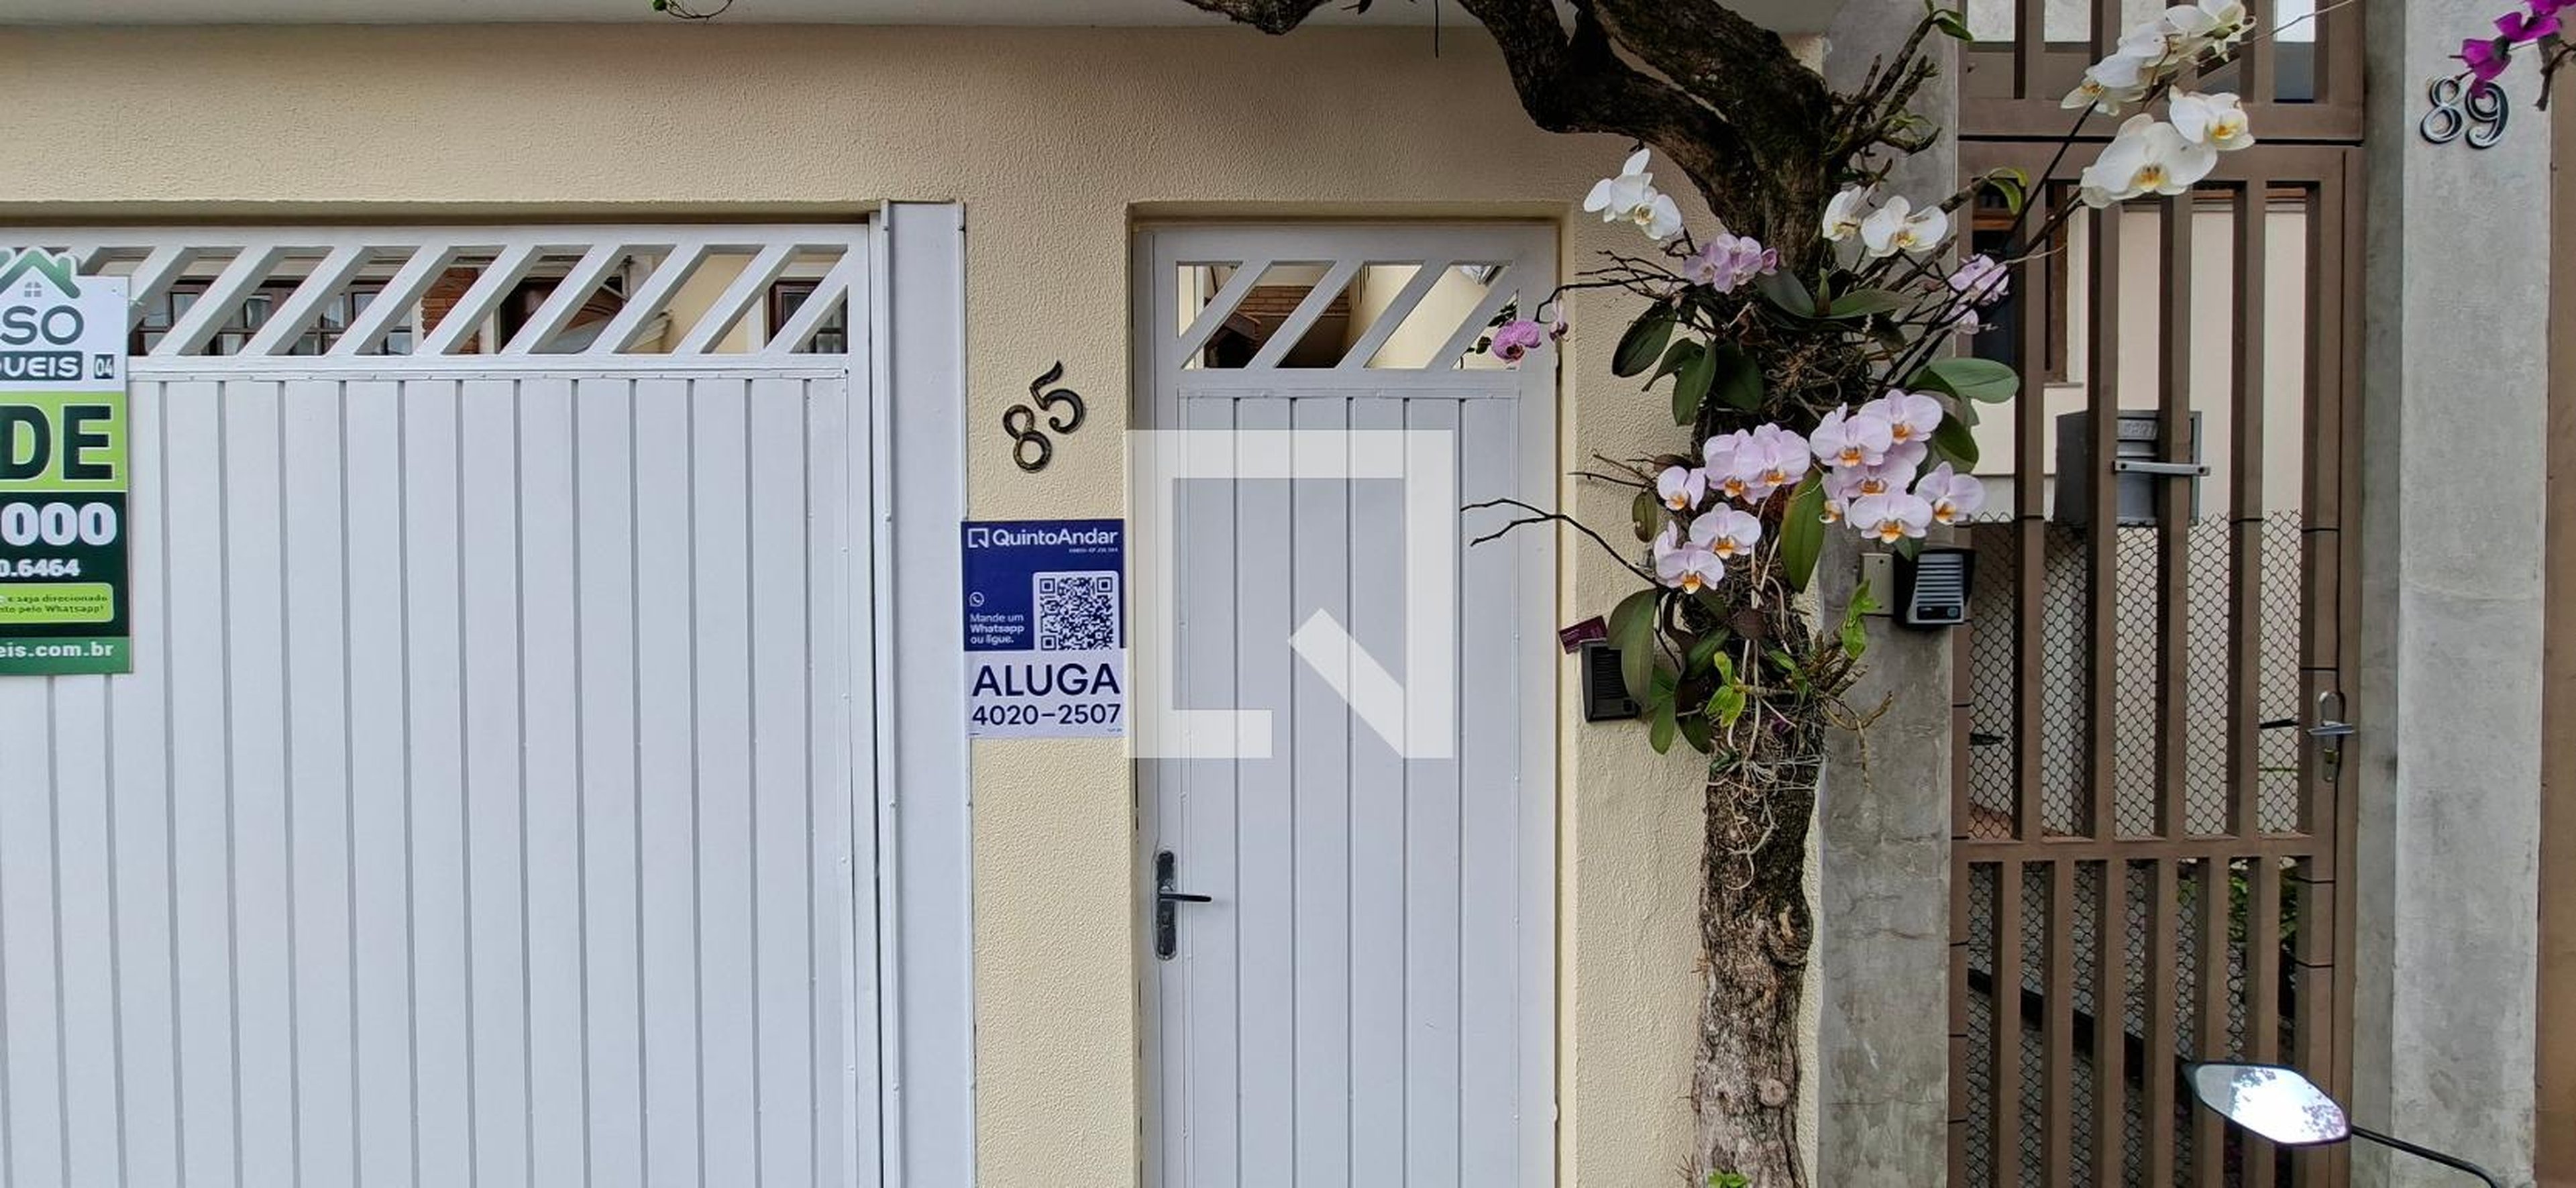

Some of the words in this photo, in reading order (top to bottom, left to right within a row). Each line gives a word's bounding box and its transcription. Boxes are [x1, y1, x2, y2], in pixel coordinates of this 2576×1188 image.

[2420, 76, 2509, 150] 89
[0, 305, 84, 345] SO
[0, 357, 78, 377] UEIS
[1003, 360, 1086, 474] 85
[0, 403, 115, 482] DE
[992, 528, 1119, 546] QuintoAndar
[42, 594, 107, 602] direcionado
[970, 613, 1006, 623] Mande
[1008, 614, 1024, 623] um
[970, 624, 1025, 635] Whatsapp
[970, 636, 984, 644] ou
[985, 634, 1014, 645] ligue.
[972, 663, 1121, 696] ALUGA
[972, 704, 1121, 726] 4020-2507
